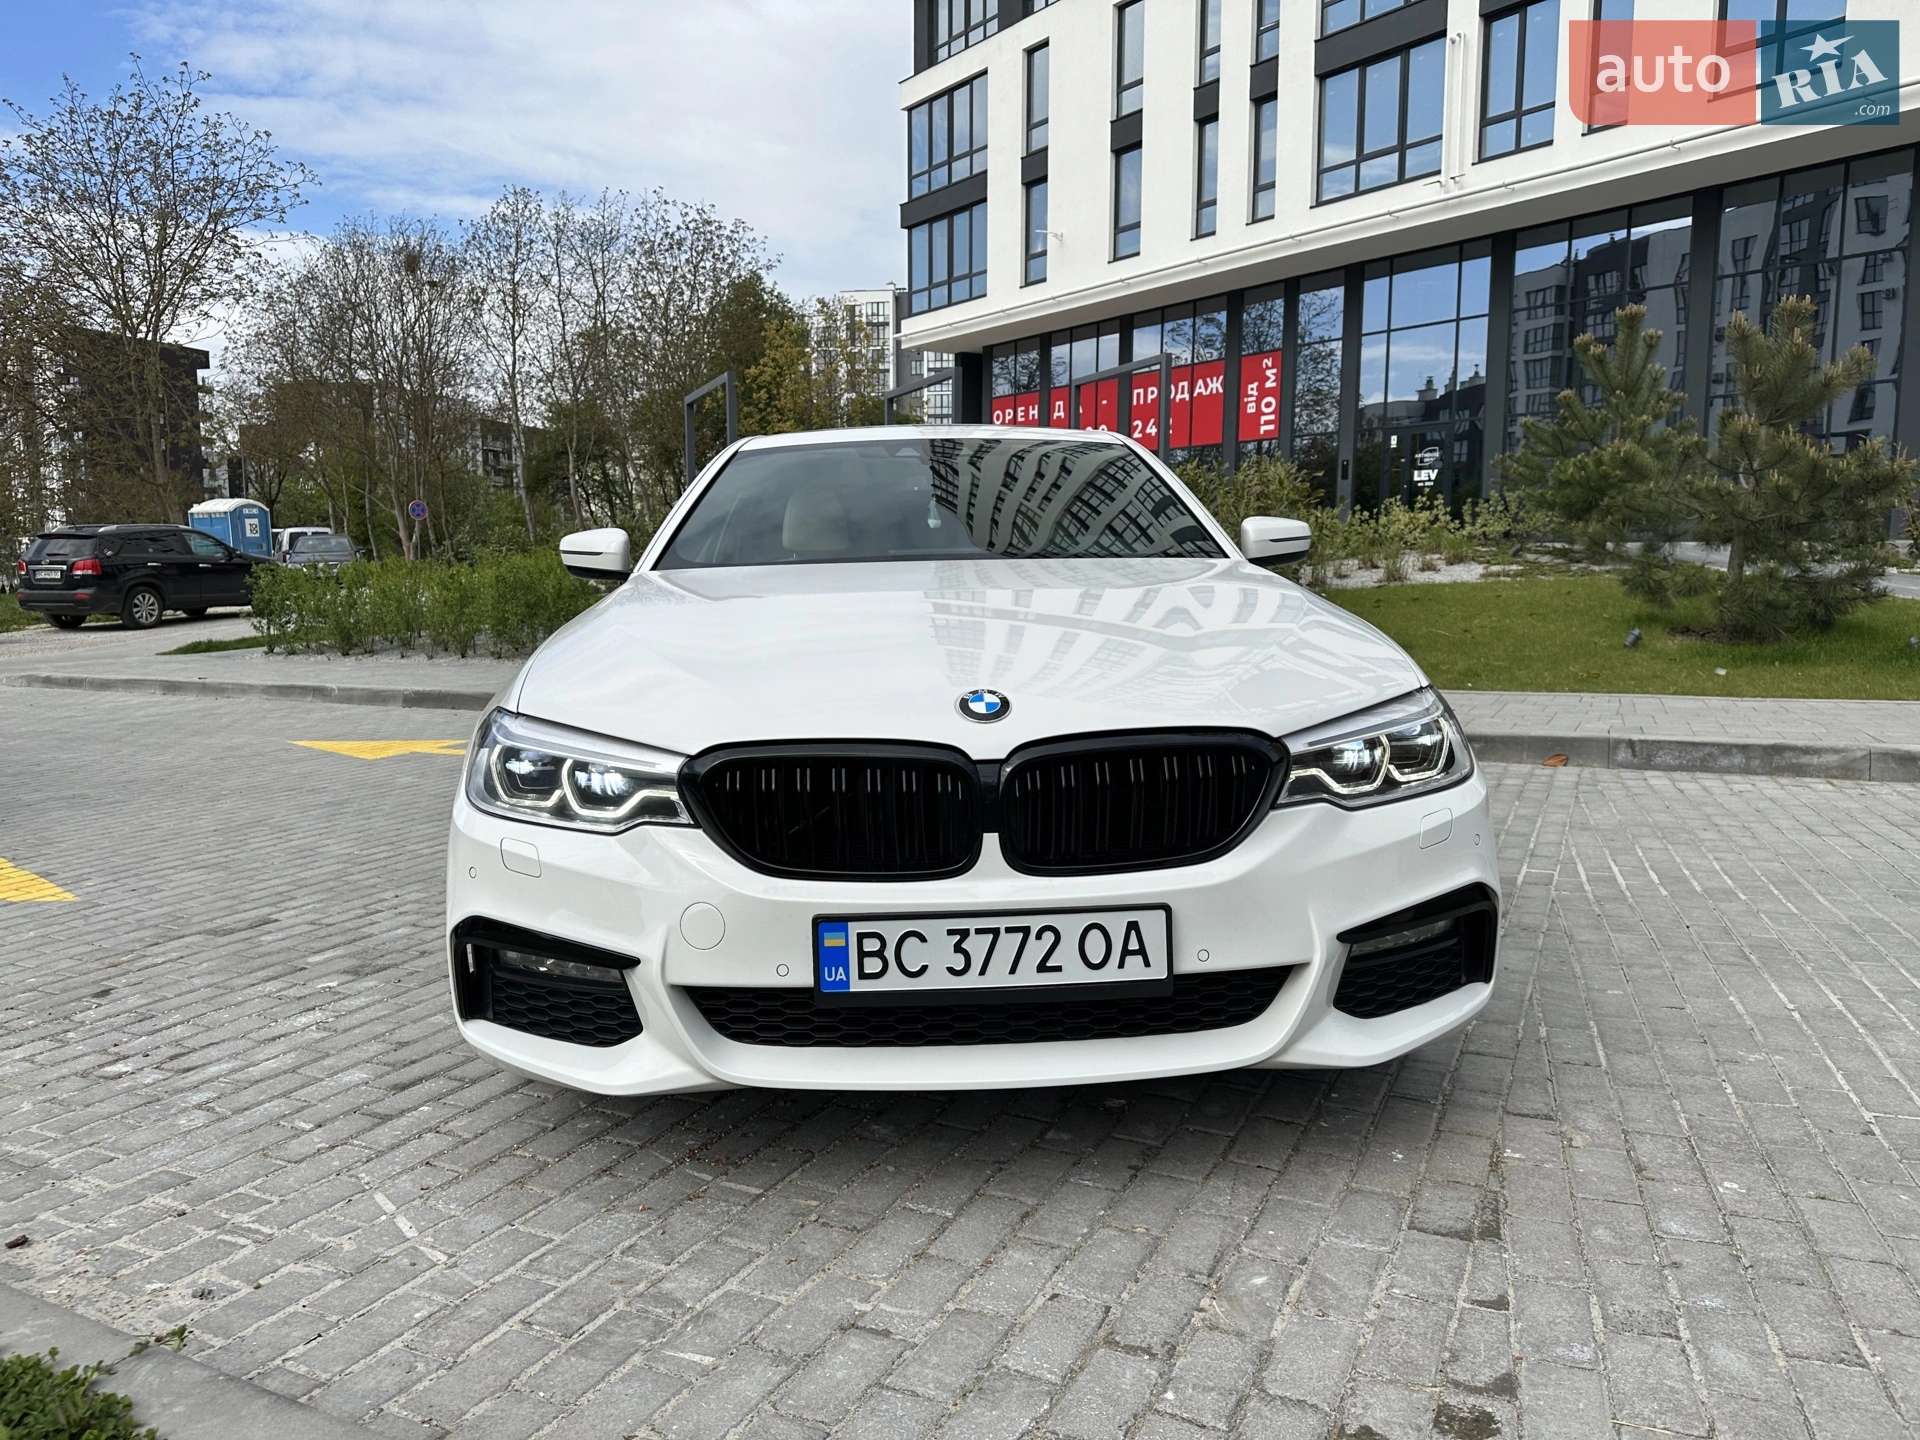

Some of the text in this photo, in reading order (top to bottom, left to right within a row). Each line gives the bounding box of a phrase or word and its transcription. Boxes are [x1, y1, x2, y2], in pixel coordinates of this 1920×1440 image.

[993, 400, 1083, 425] ОРЕНД
[1260, 396, 1276, 435] 110
[1132, 418, 1173, 439] 24
[1413, 469, 1438, 481] LEV
[856, 919, 1151, 980] BC 3772 OA
[824, 966, 847, 982] UA
